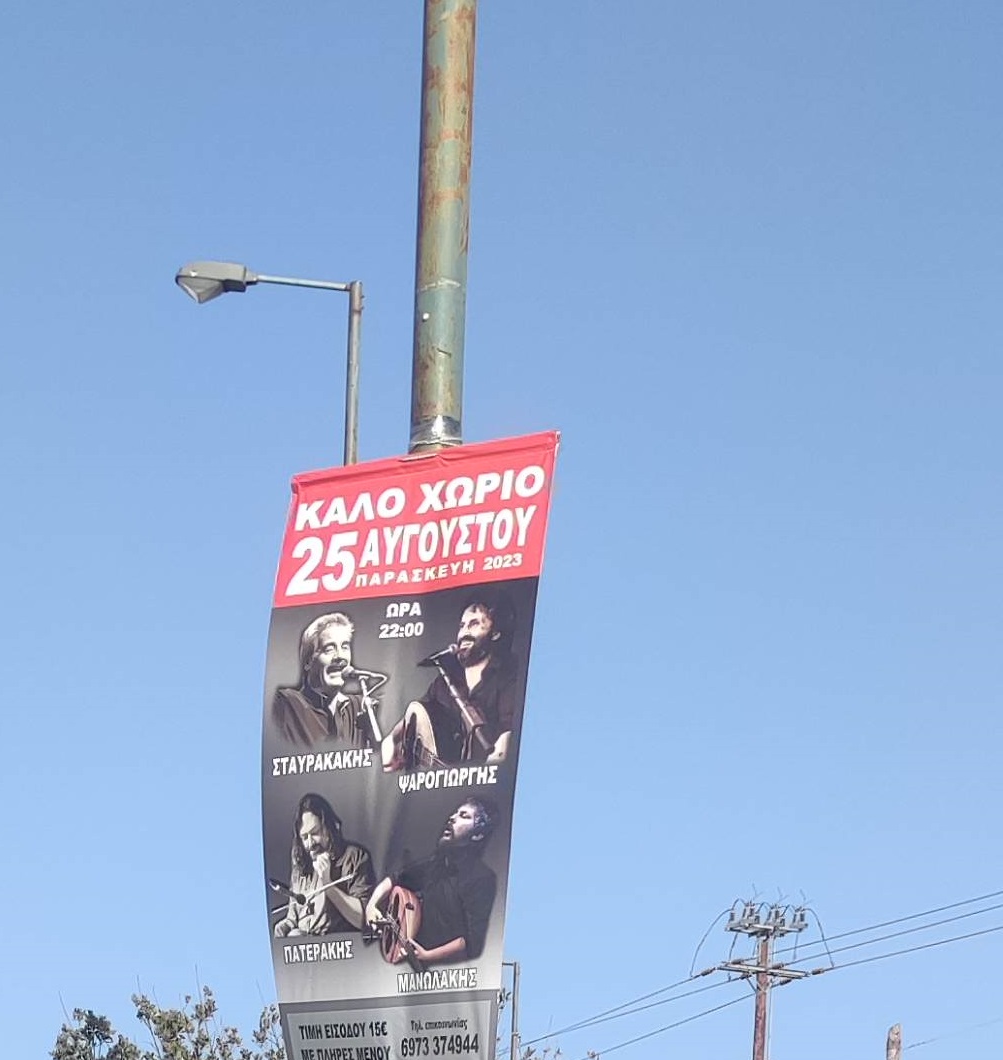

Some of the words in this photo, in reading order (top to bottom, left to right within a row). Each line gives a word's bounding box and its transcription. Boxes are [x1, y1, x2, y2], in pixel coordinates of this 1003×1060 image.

[295, 487, 406, 531] ΚΑΛΟ
[416, 465, 545, 514] ΧΩΡΙΟ
[285, 531, 359, 597] 25
[359, 504, 538, 568] ΑΥΓΟΥΣΤΟΥ
[355, 559, 475, 588] ΠΑΡΑΣΚΕΥΗ
[483, 552, 522, 572] 2023
[386, 602, 422, 618] ΩΡΑ
[378, 622, 425, 639] 22:00
[272, 749, 374, 776] ΣΤΑΥΡΑΚΑΚΗΣ
[398, 765, 498, 794] ΨΑΡΟΓΙΩΡΓΗΣ
[283, 940, 355, 964] ΠΑΤΕΡΑΚΗΣ
[397, 968, 478, 993] ΜΑΝΩΛΑΚΗΣ
[298, 1023, 323, 1040] ΤΙΜΗ
[325, 1022, 367, 1039] ΕΙΣΟΔΟΥ
[369, 1021, 388, 1037] 15€
[401, 1037, 429, 1057] 6973
[432, 1034, 479, 1055] 374944
